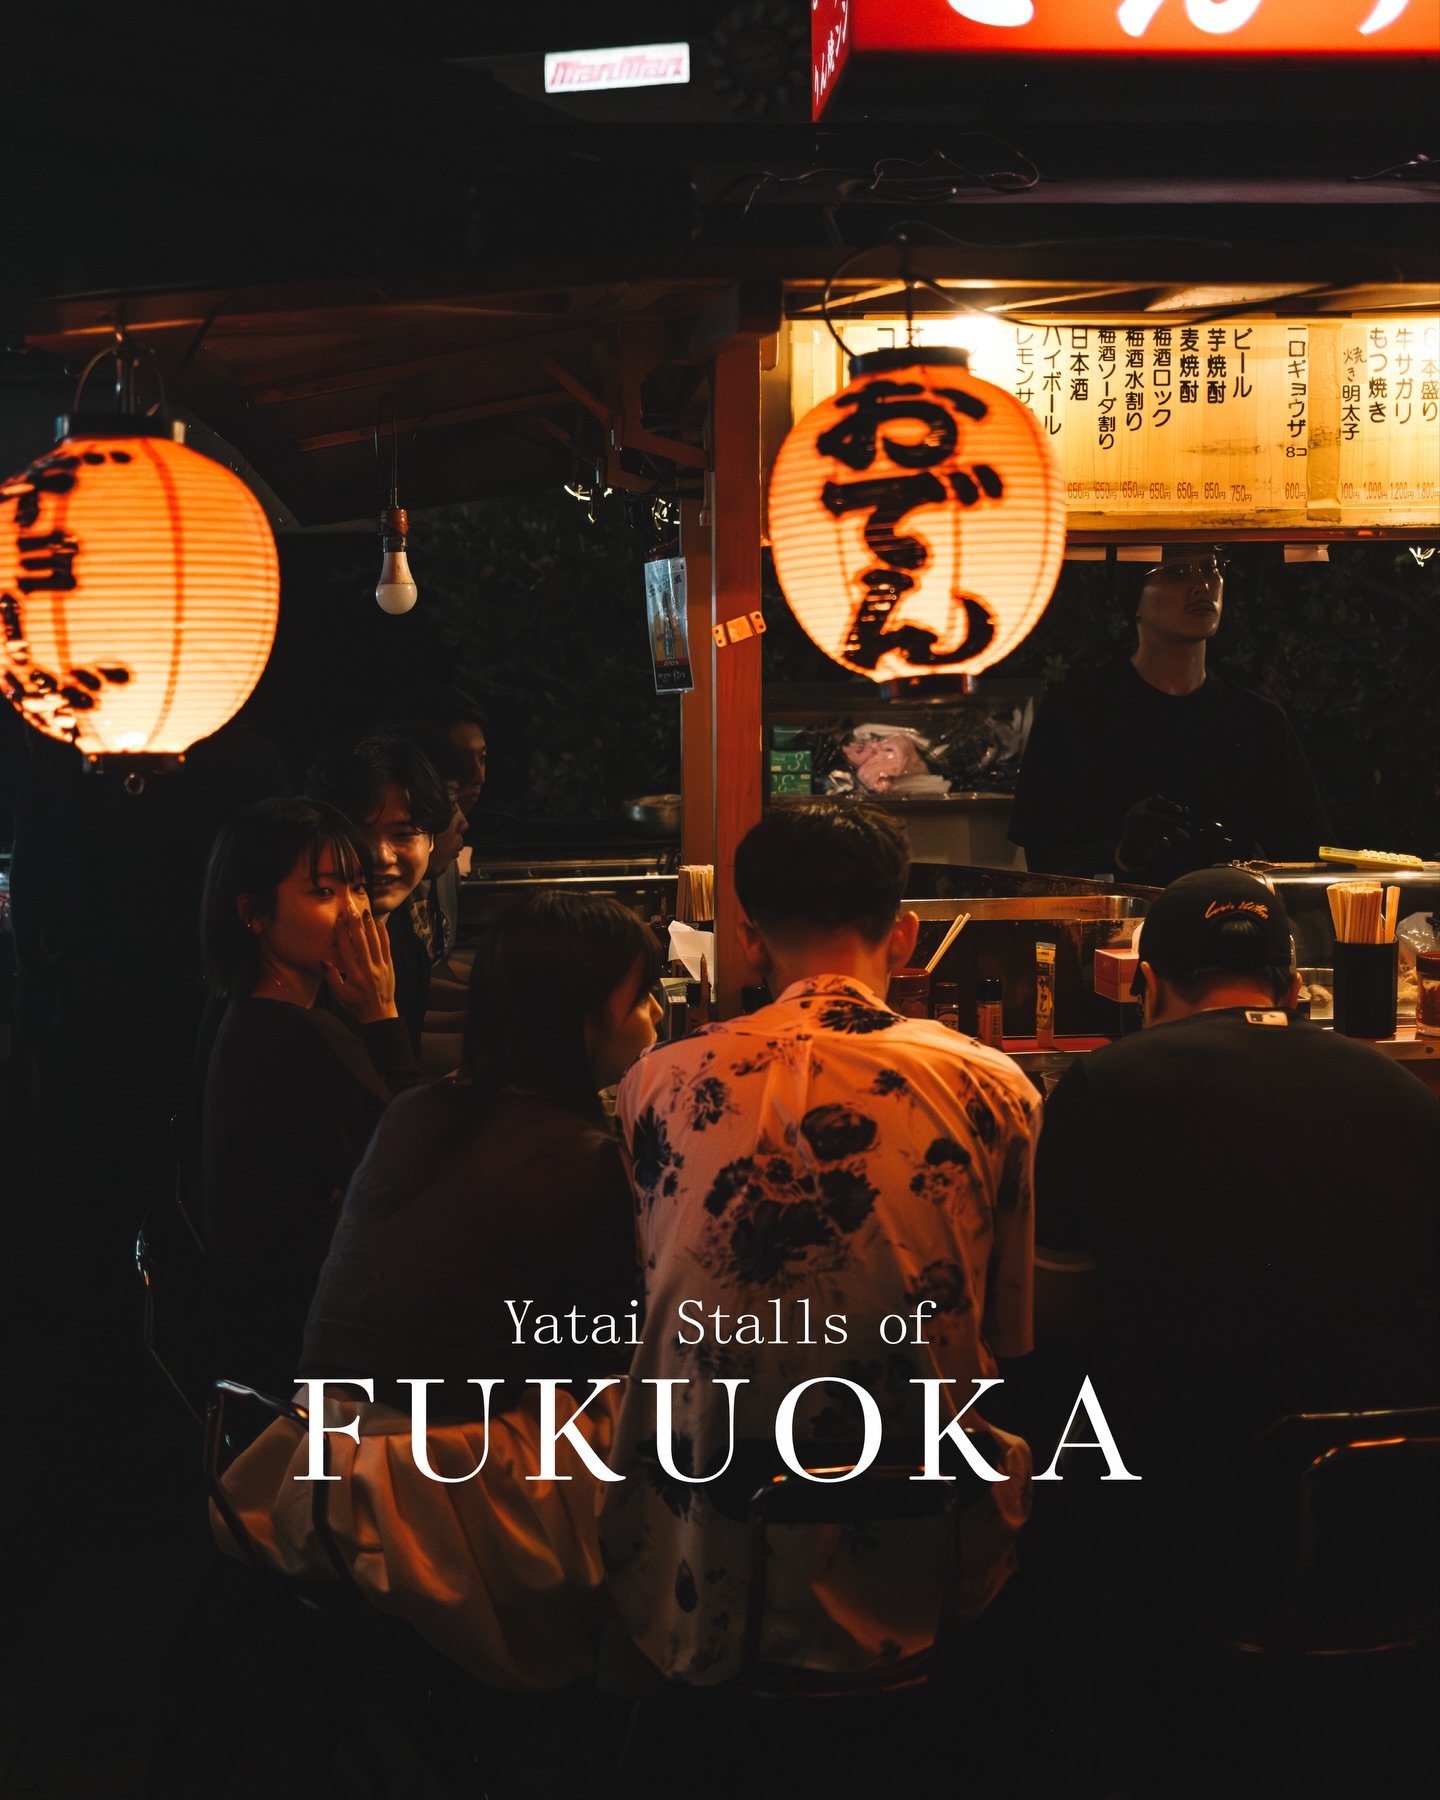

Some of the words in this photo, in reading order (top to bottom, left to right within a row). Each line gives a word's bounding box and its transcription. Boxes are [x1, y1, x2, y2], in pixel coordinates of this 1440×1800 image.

[1043, 326, 1062, 435] ハイボール
[1070, 327, 1089, 401] 日本酒
[1097, 328, 1117, 450] 梅酒ソーダ割り
[1125, 328, 1144, 431] 梅酒水割り
[1152, 327, 1172, 427] 梅酒ロック
[1179, 327, 1199, 403] 麦焼酎
[1206, 327, 1226, 404] 芋焼酎
[1232, 327, 1253, 398] ビール
[1368, 327, 1388, 424] もつ焼き
[1395, 327, 1414, 425] 牛サガリ
[816, 380, 1004, 672] おでん
